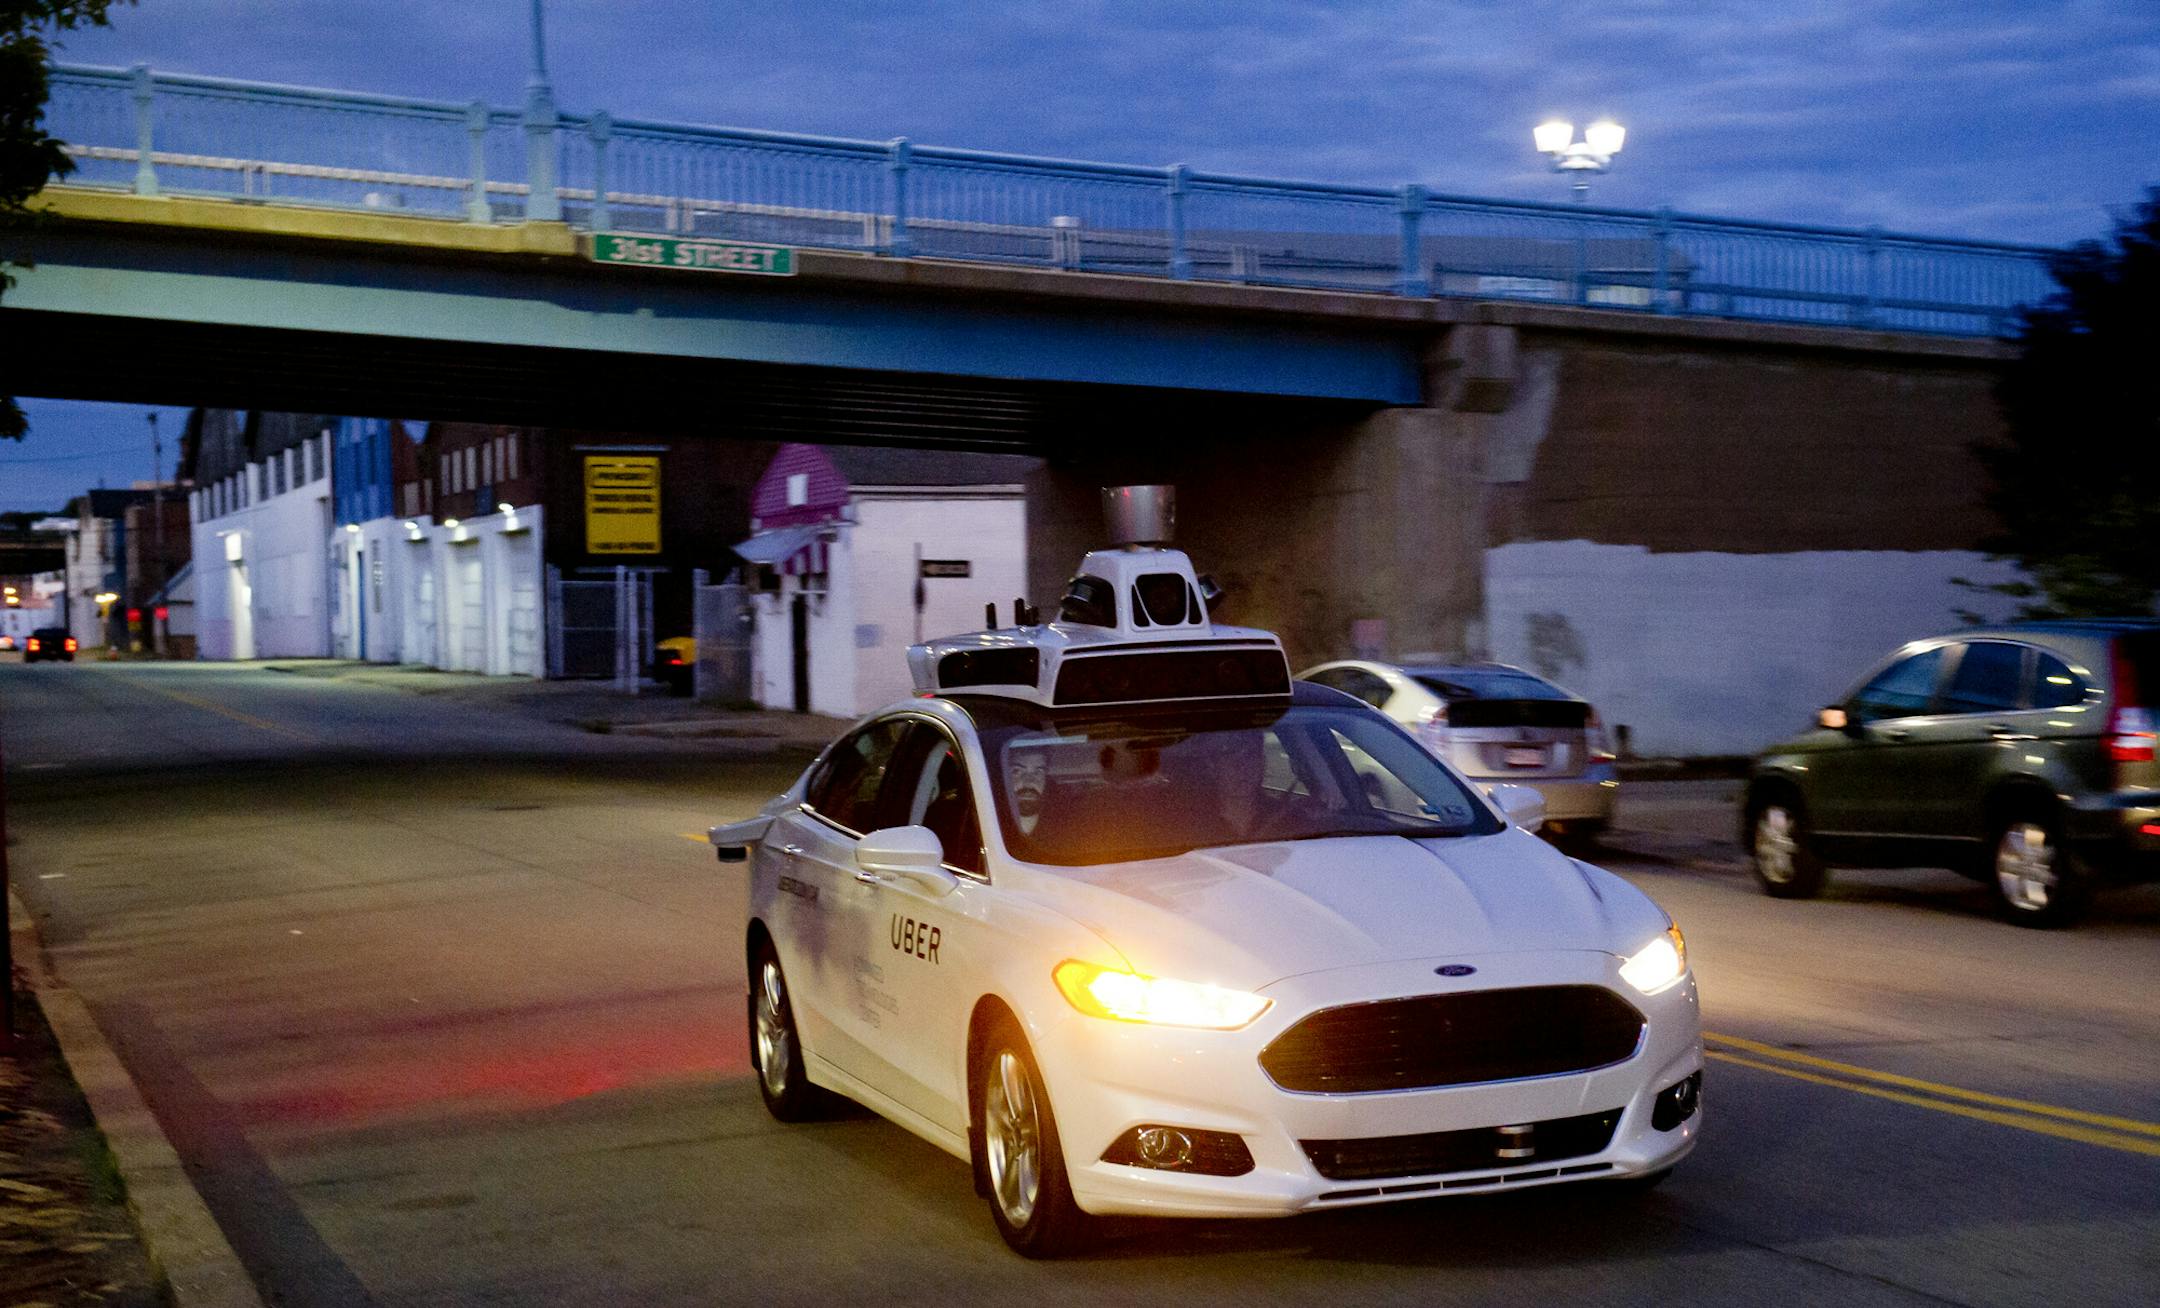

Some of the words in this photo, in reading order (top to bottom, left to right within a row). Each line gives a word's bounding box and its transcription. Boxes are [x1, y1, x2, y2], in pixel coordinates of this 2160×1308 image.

[610, 237, 664, 263] 31st
[674, 242, 778, 271] STREET
[890, 912, 942, 965] UBER
